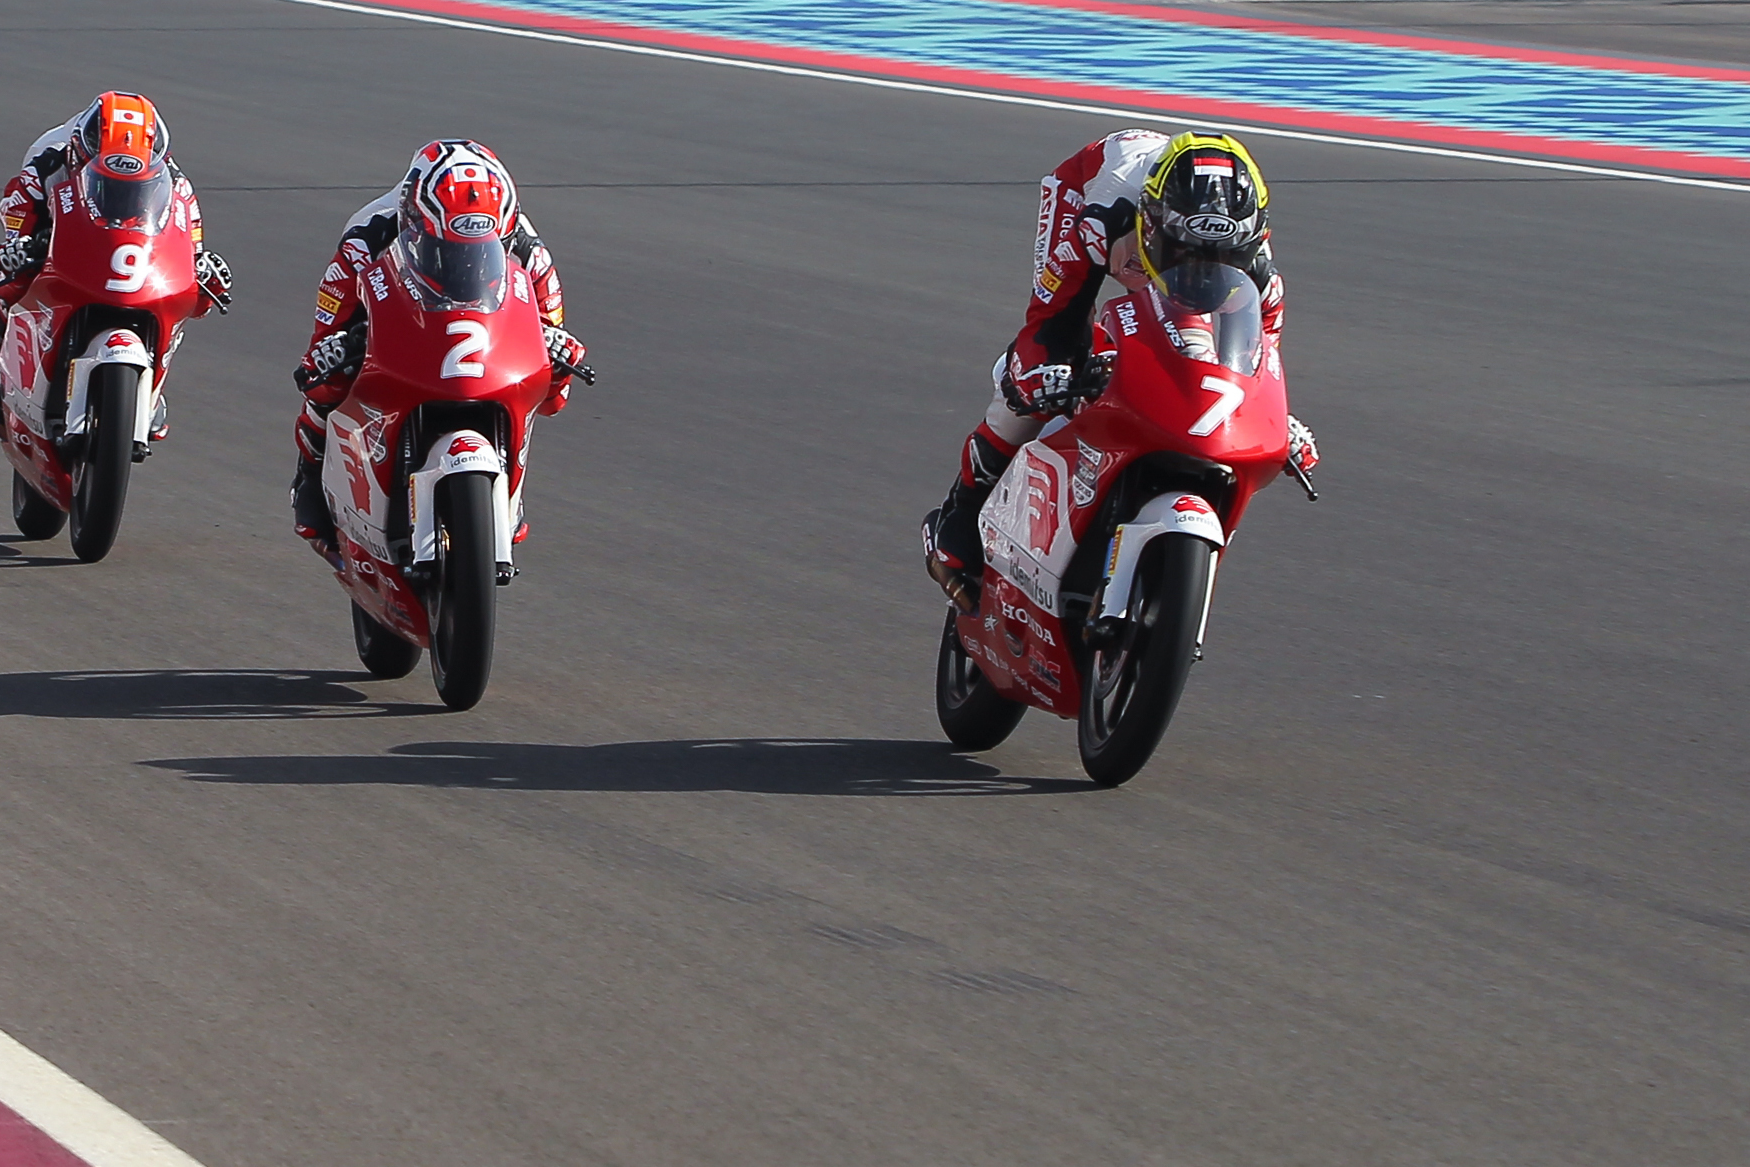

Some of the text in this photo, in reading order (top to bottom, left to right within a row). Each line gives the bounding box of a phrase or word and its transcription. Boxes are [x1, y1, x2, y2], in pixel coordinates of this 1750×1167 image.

[109, 156, 139, 169] Arai
[454, 216, 492, 230] Arai
[1037, 185, 1053, 237] ASIA
[1190, 218, 1231, 233] Arai
[105, 243, 151, 293] 9
[370, 272, 389, 301] Beta
[1119, 306, 1139, 336] Beta
[1163, 320, 1186, 347] WRS
[440, 319, 491, 379] 2
[1188, 375, 1246, 436] 7
[1001, 602, 1057, 646] HONDA
